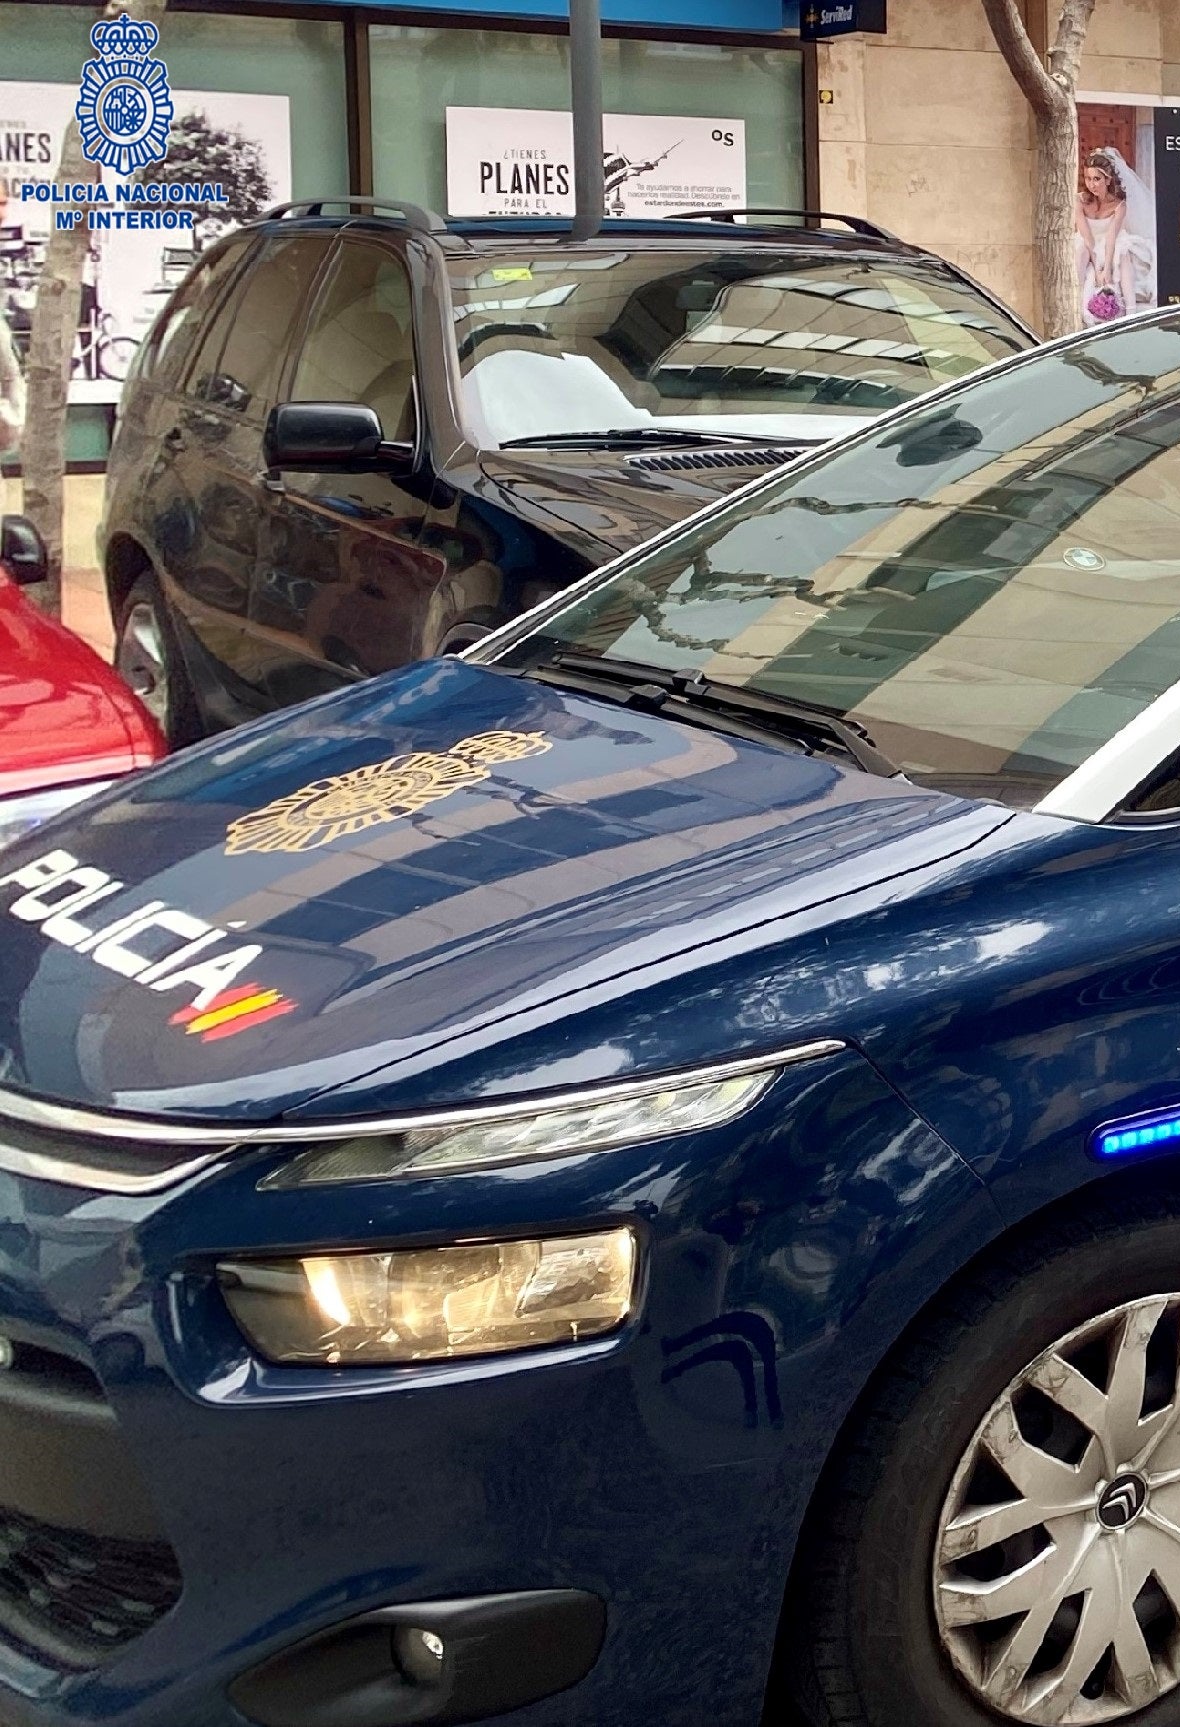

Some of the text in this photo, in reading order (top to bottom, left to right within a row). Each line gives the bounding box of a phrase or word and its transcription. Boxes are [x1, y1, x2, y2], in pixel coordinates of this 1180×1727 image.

[0, 132, 51, 163] NES
[479, 161, 569, 195] PLANES
[504, 197, 548, 209] PARA EL
[0, 849, 263, 1012] POLICÍA
